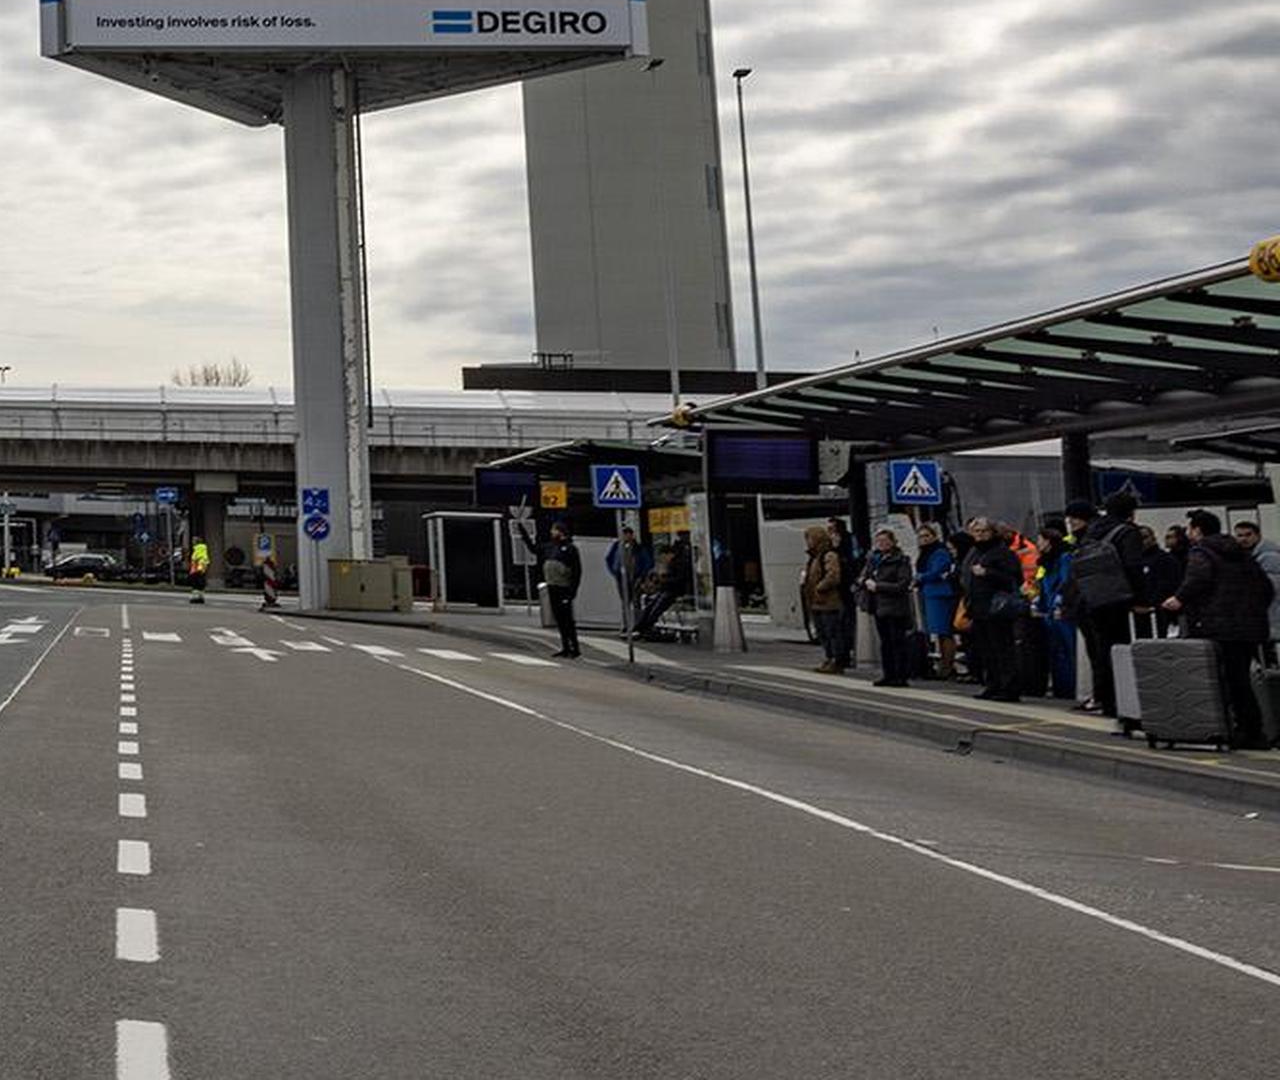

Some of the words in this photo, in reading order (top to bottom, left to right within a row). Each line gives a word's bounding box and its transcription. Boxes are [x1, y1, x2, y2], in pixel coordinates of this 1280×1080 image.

[96, 15, 164, 30] Investing
[167, 16, 228, 28] involves
[231, 15, 260, 28] risk
[262, 16, 278, 27] of
[280, 16, 316, 28] loss.
[477, 10, 608, 35] DEGIRO
